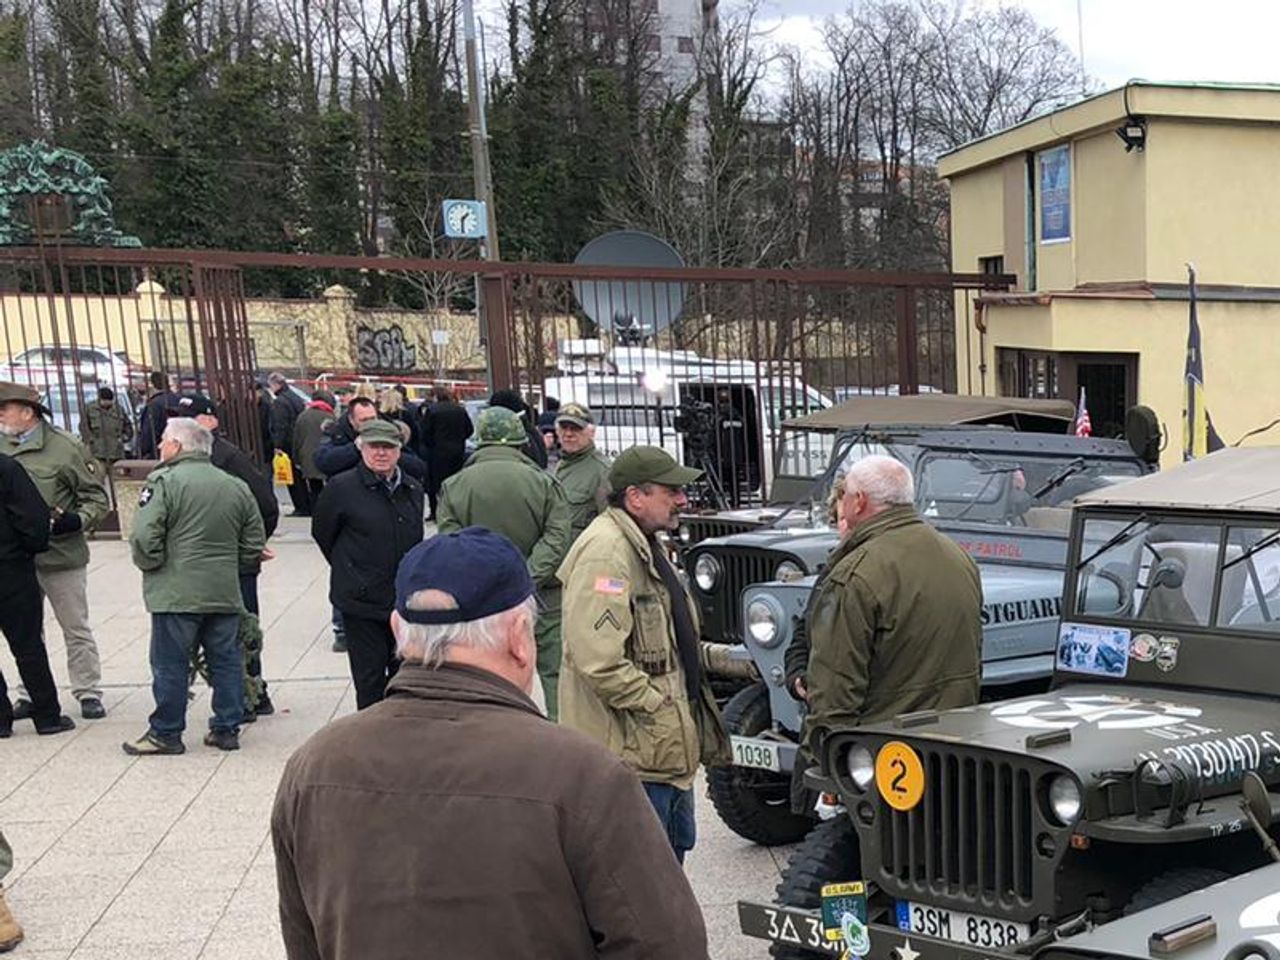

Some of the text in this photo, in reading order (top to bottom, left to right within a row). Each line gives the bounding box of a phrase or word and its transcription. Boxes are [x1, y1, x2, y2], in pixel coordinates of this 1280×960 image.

[736, 744, 773, 767] 1038
[891, 758, 907, 793] 2
[913, 906, 1018, 947] 3SM 8338
